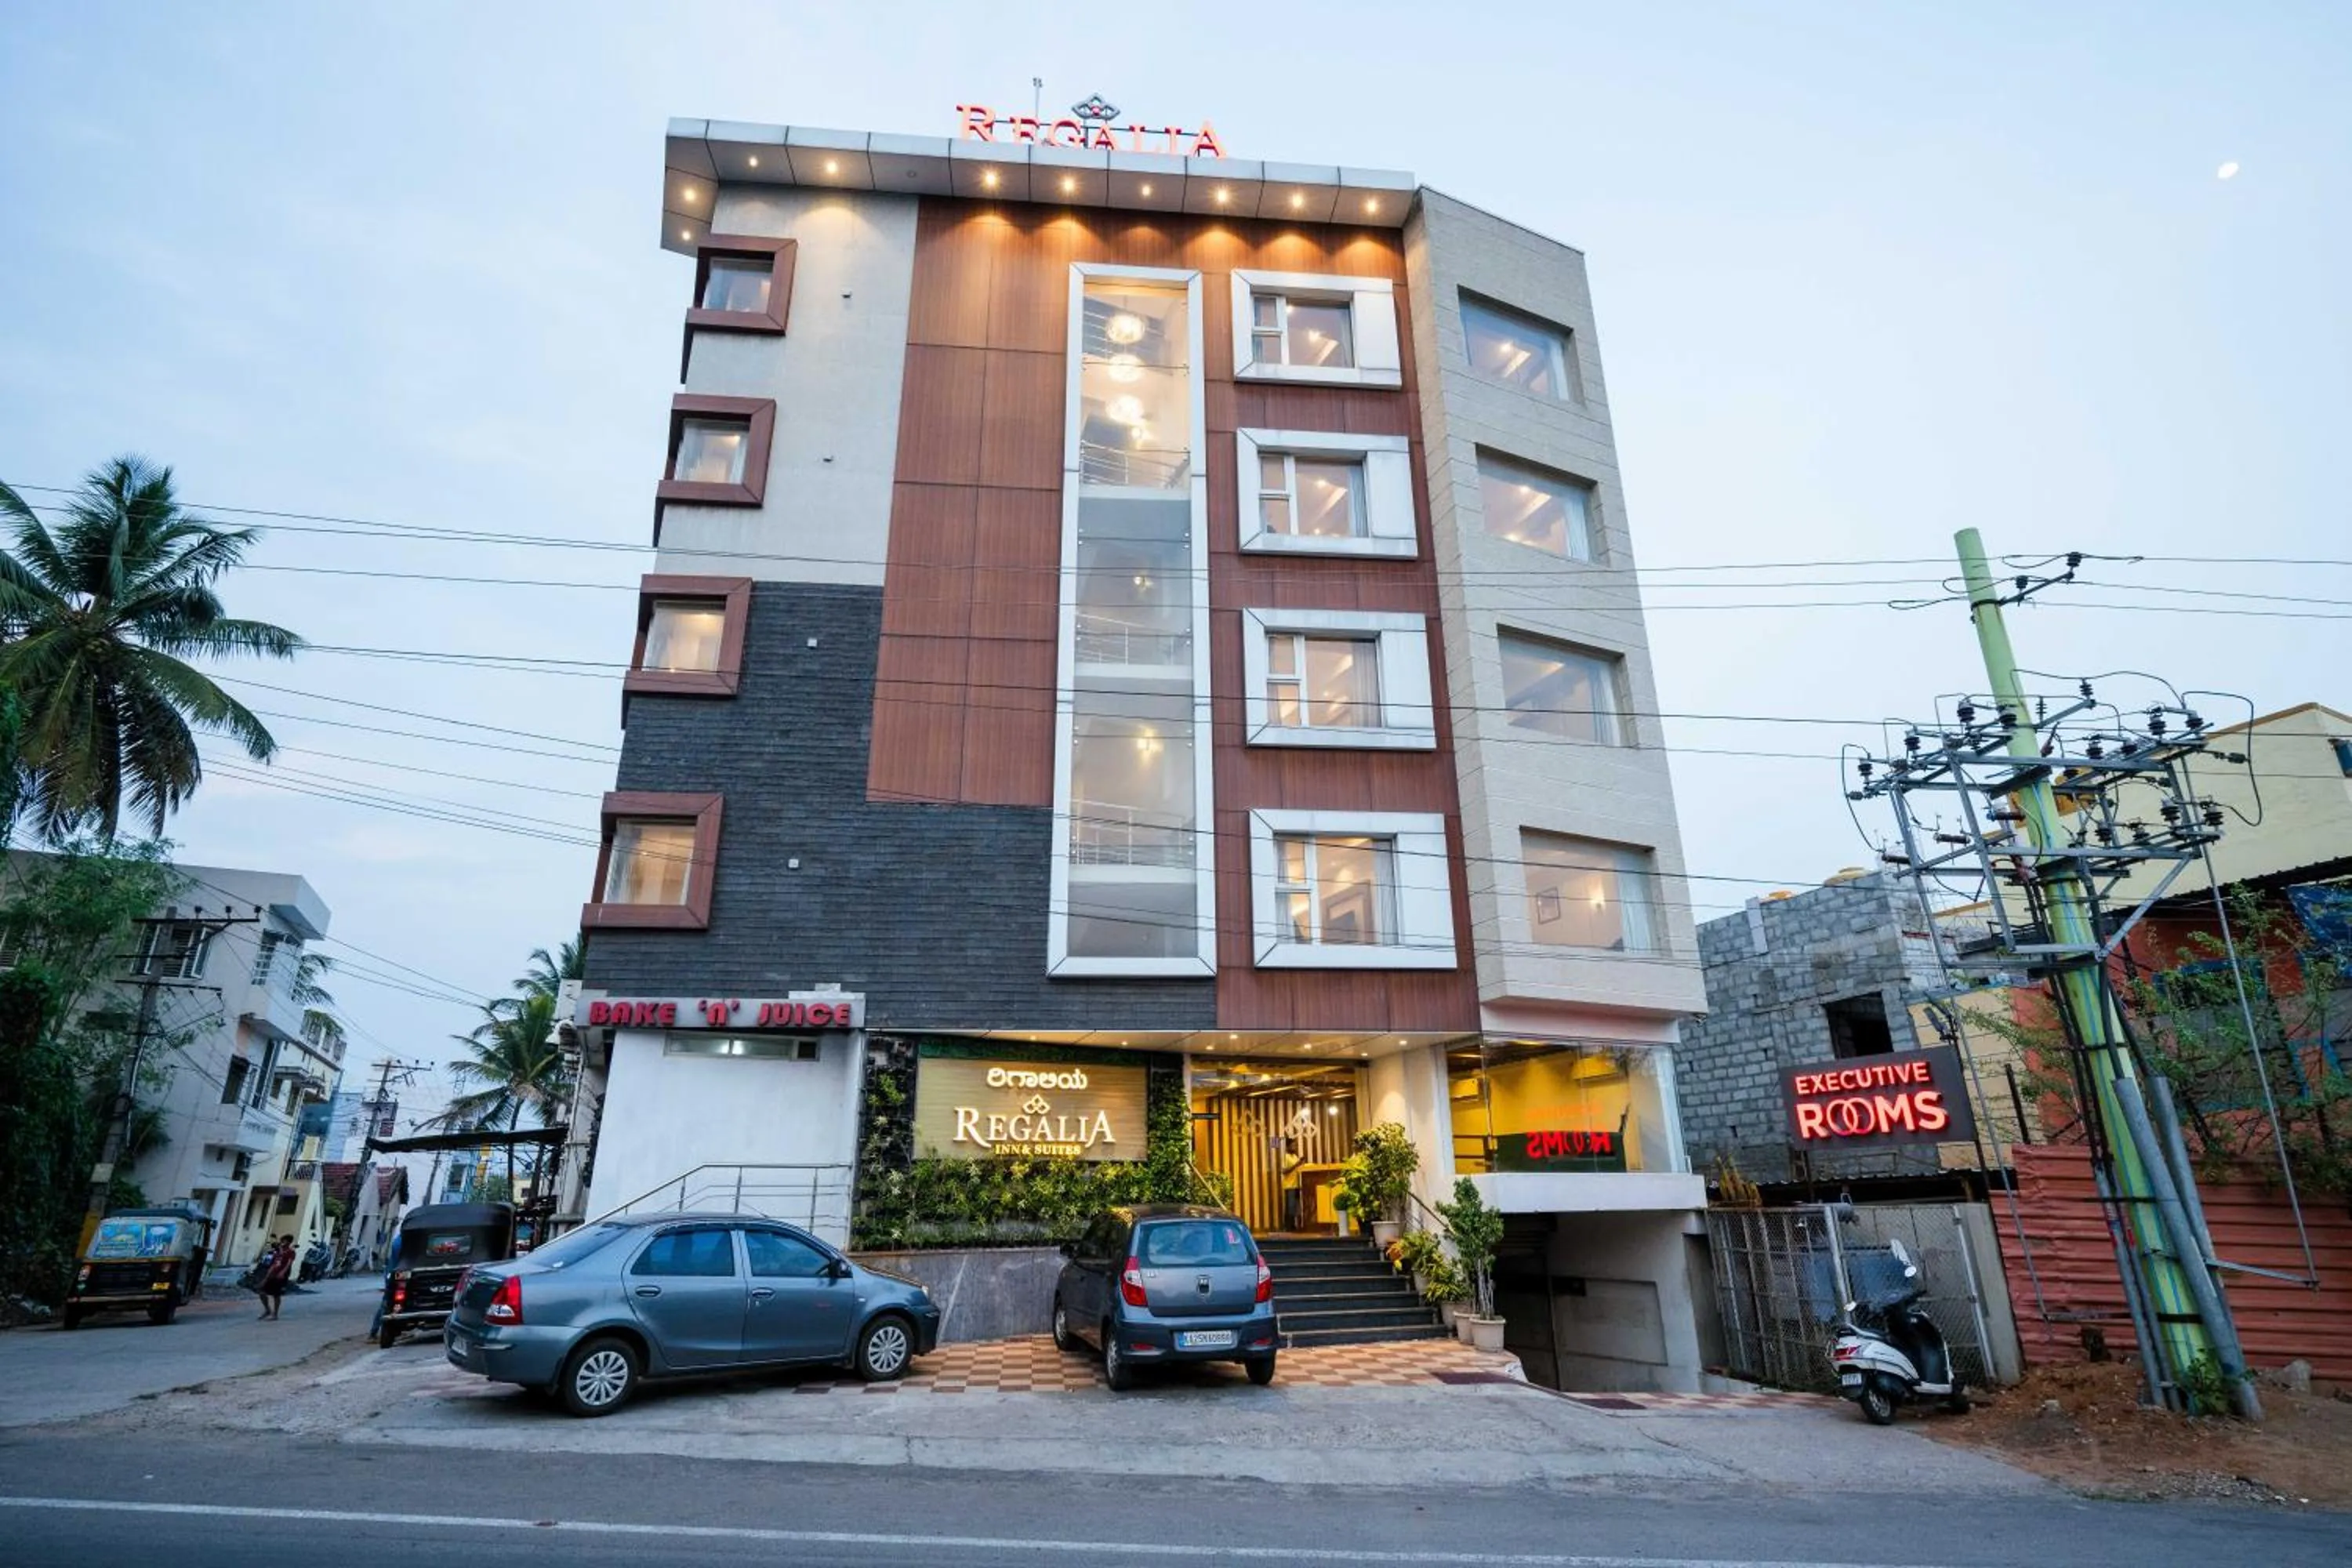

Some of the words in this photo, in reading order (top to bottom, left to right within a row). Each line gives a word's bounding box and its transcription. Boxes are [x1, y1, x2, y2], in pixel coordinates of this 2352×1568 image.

[956, 104, 1228, 159] REGALIA
[590, 1002, 677, 1026] BAKE
[757, 1003, 851, 1027] JUICE
[1795, 1062, 1933, 1095] EXECUTIVE
[953, 1106, 1116, 1148] REGALIA
[1795, 1090, 1950, 1139] ROOMS
[995, 1144, 1020, 1155] INN
[1034, 1144, 1081, 1155] SUITES
